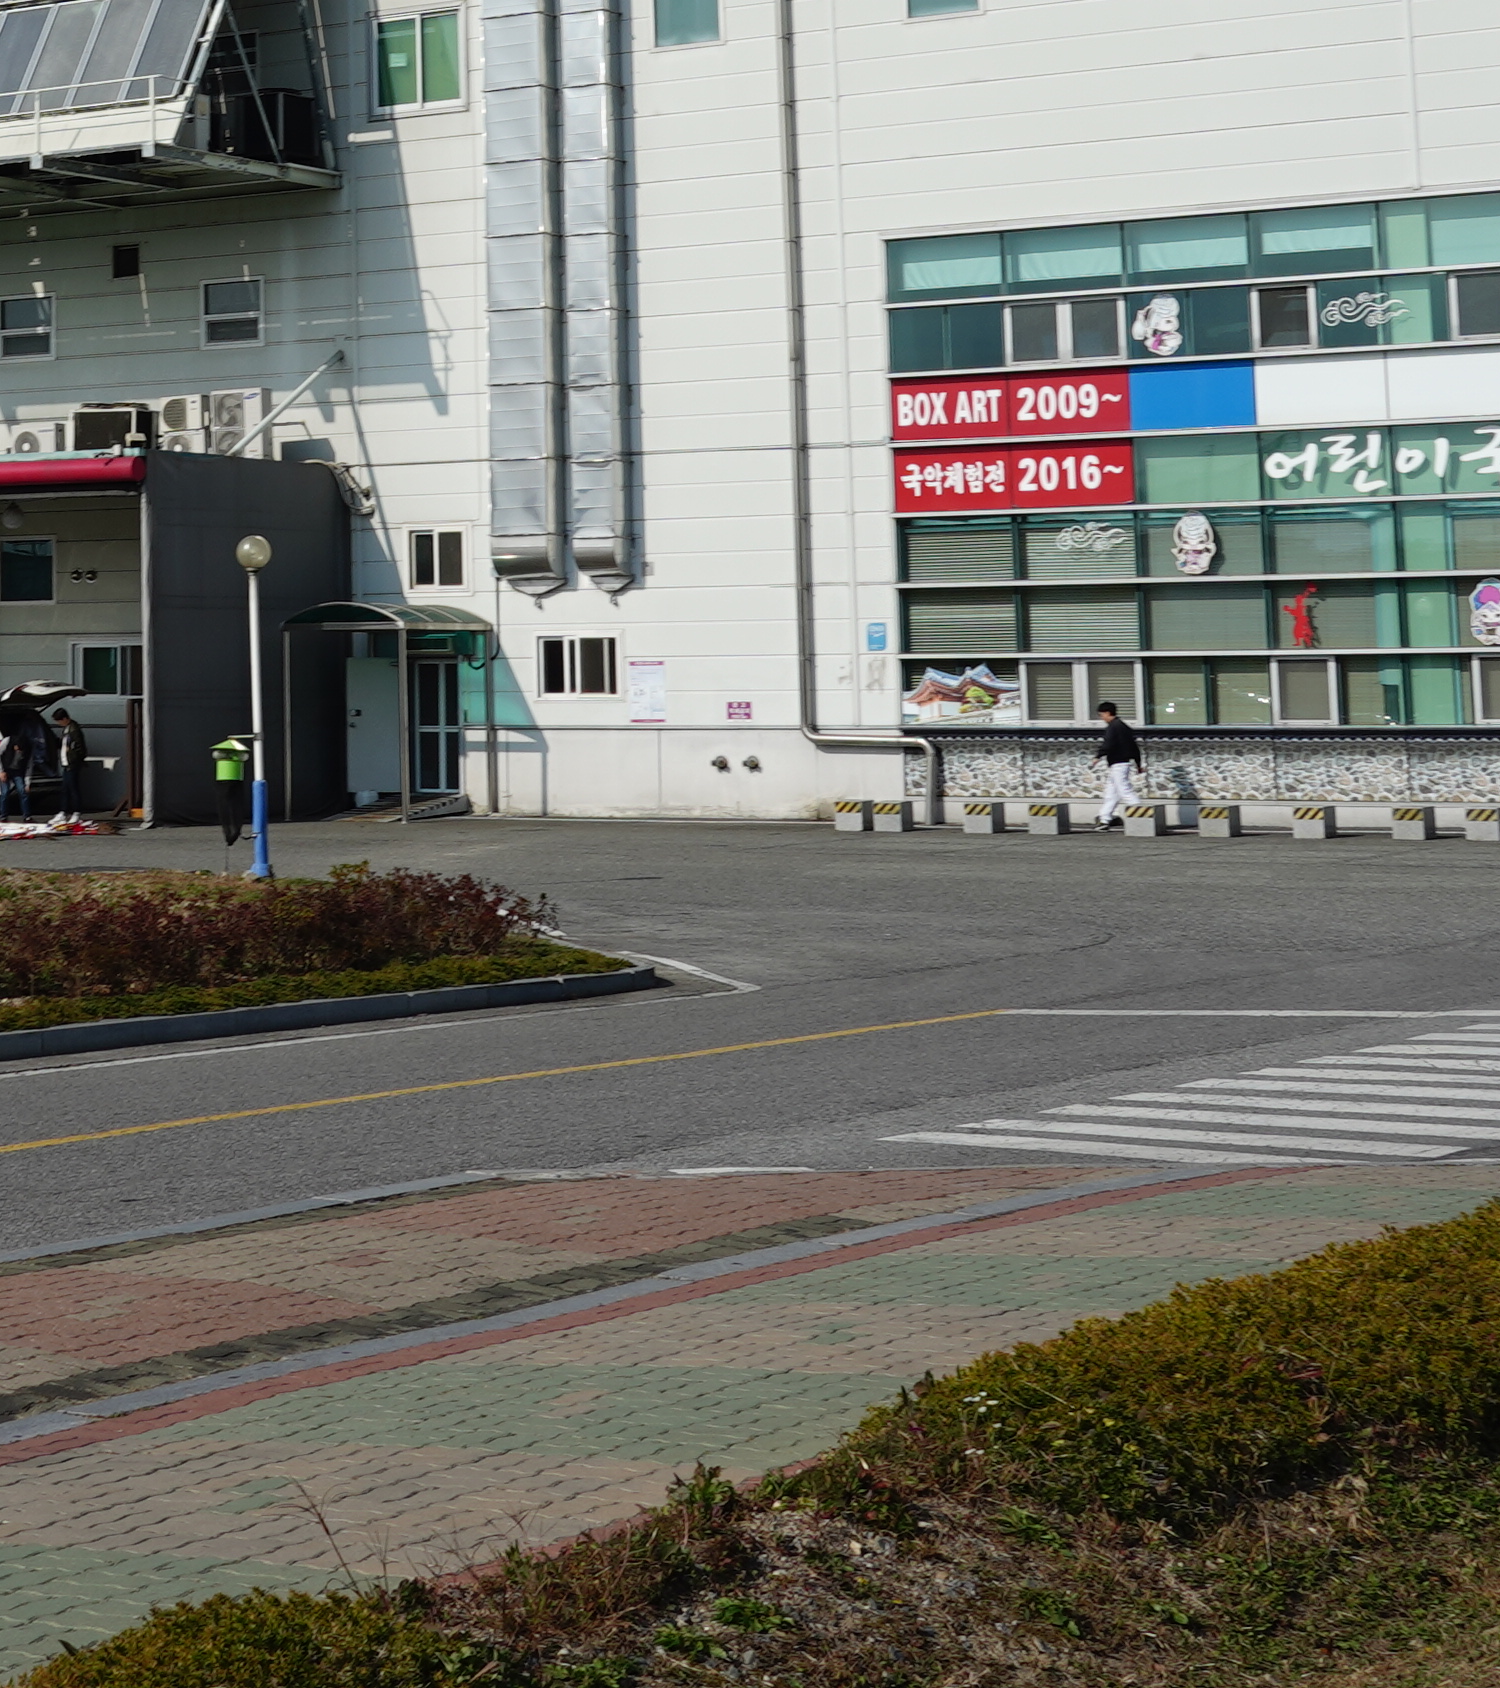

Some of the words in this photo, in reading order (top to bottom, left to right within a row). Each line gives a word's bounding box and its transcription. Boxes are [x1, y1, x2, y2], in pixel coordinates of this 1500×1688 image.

[897, 392, 948, 427] BOX
[954, 389, 1002, 424] ART
[1016, 383, 1123, 421] 2009~
[900, 459, 1006, 497] 국악체험전
[1017, 454, 1125, 492] 2016~
